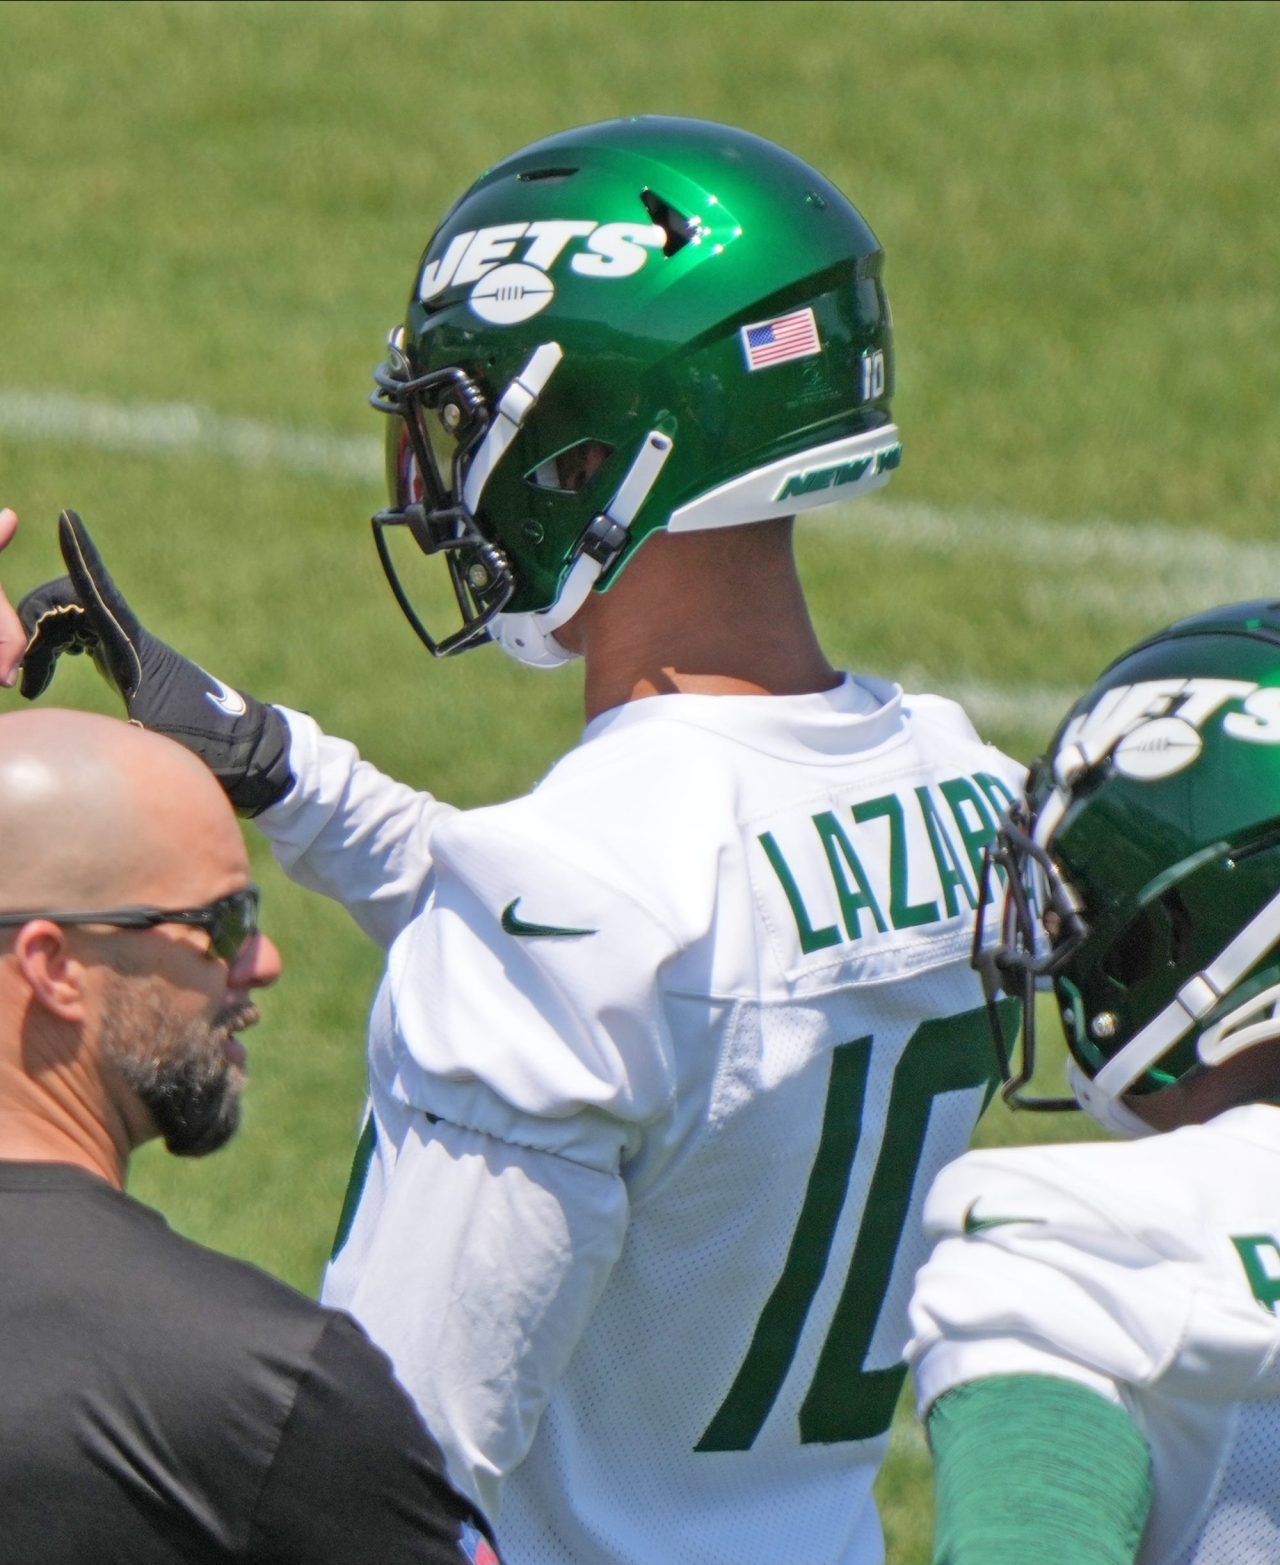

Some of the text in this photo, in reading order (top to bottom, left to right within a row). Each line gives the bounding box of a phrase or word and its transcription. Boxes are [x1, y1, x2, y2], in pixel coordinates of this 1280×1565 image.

[419, 220, 668, 301] JETS
[863, 356, 884, 400] 10
[772, 453, 875, 501] NEW
[1054, 677, 1280, 783] JETS
[693, 996, 1022, 1454] 10
